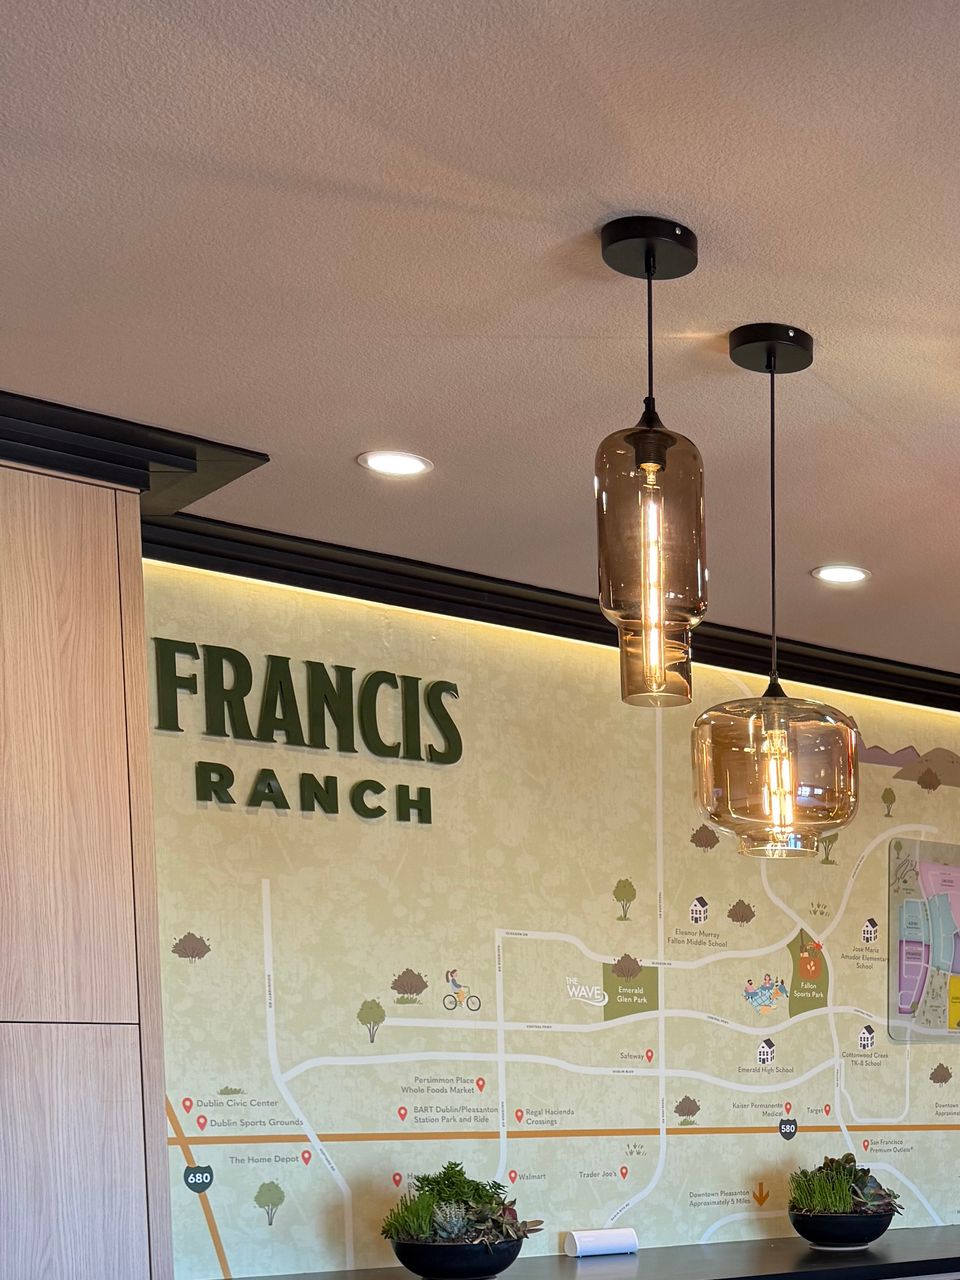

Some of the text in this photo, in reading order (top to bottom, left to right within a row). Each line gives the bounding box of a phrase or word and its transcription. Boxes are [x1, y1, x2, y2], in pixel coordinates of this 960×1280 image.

[151, 637, 463, 764] FRANCIS
[195, 761, 432, 824] RANCH
[675, 928, 720, 939] Eleanor Murray
[667, 937, 728, 948] Fallon Middle School
[840, 953, 860, 962] Amador
[565, 976, 578, 984] THE
[618, 986, 644, 994] Emerald
[801, 982, 817, 990] Fallon
[566, 986, 601, 999] WAVE
[793, 990, 824, 999] Sports Park
[620, 1052, 644, 1061] Safeway
[761, 1066, 775, 1074] High
[414, 1076, 475, 1084] Persimmon Place
[400, 1086, 475, 1094] Whole Foods Market
[196, 1098, 279, 1107] Dublin Civic Center
[413, 1106, 499, 1114] BART Dublin/Pleasanton
[525, 1108, 575, 1117] Regal Hacienda
[806, 1107, 824, 1115] Target
[210, 1118, 304, 1128] Dublin Sports Grounds
[414, 1116, 440, 1124] Station
[473, 1115, 489, 1123] Ride
[526, 1118, 558, 1126] Crossings
[781, 1125, 795, 1133] 580
[229, 1155, 300, 1165] The Home Depot
[187, 1173, 211, 1183] 680
[518, 1173, 546, 1181] Walmart
[579, 1171, 600, 1179] Trader
[689, 1199, 730, 1208] Approximately
